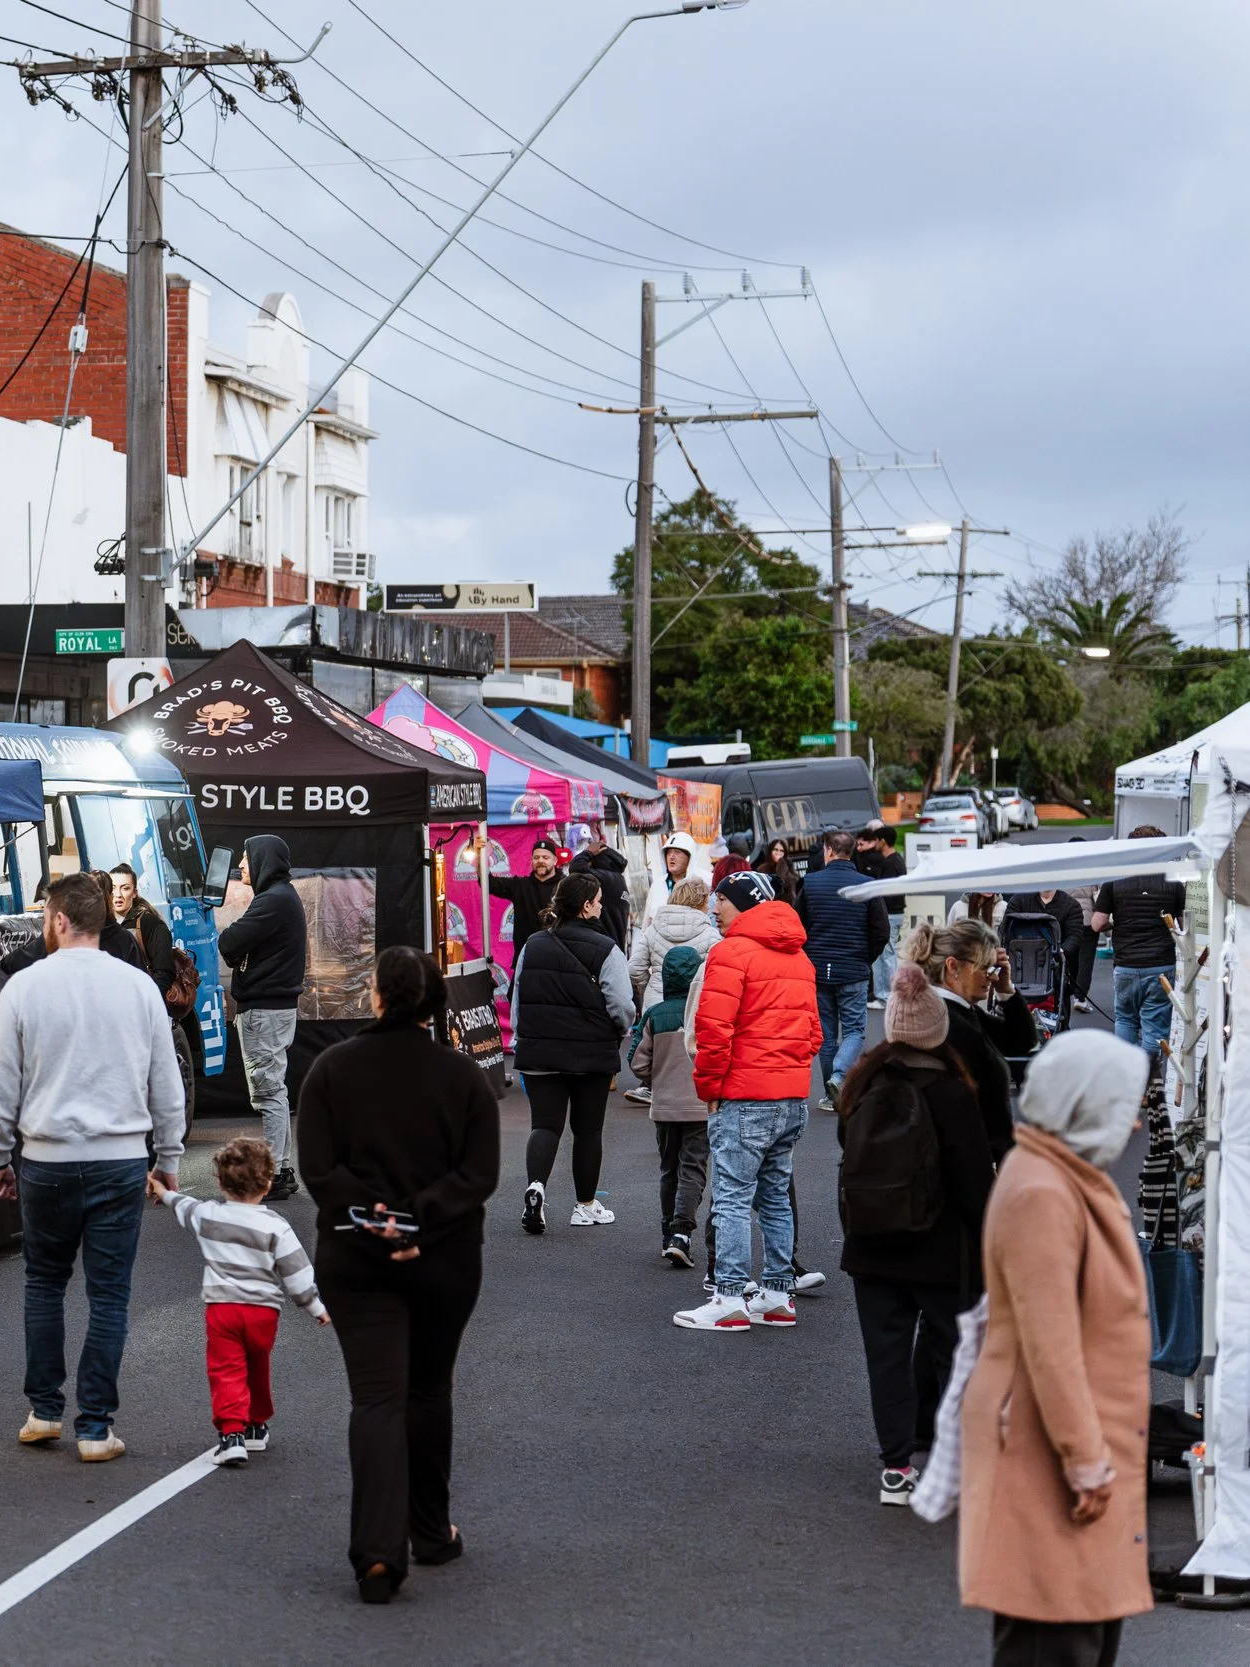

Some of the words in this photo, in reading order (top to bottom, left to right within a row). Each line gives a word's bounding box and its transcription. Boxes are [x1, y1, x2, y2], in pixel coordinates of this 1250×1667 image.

[491, 595, 520, 605] Hand
[59, 636, 103, 652] ROYAL
[108, 636, 117, 644] LA
[153, 680, 223, 720] BRAD'S
[230, 678, 266, 696] PIT
[264, 697, 293, 725] BBQ
[150, 727, 217, 757] SMOKED
[226, 730, 288, 757] MEATS
[201, 784, 294, 811] STYLE
[304, 785, 371, 816] BBQ
[436, 784, 461, 807] AMERICAN
[461, 783, 473, 806] STYLE
[473, 782, 483, 810] BBQ
